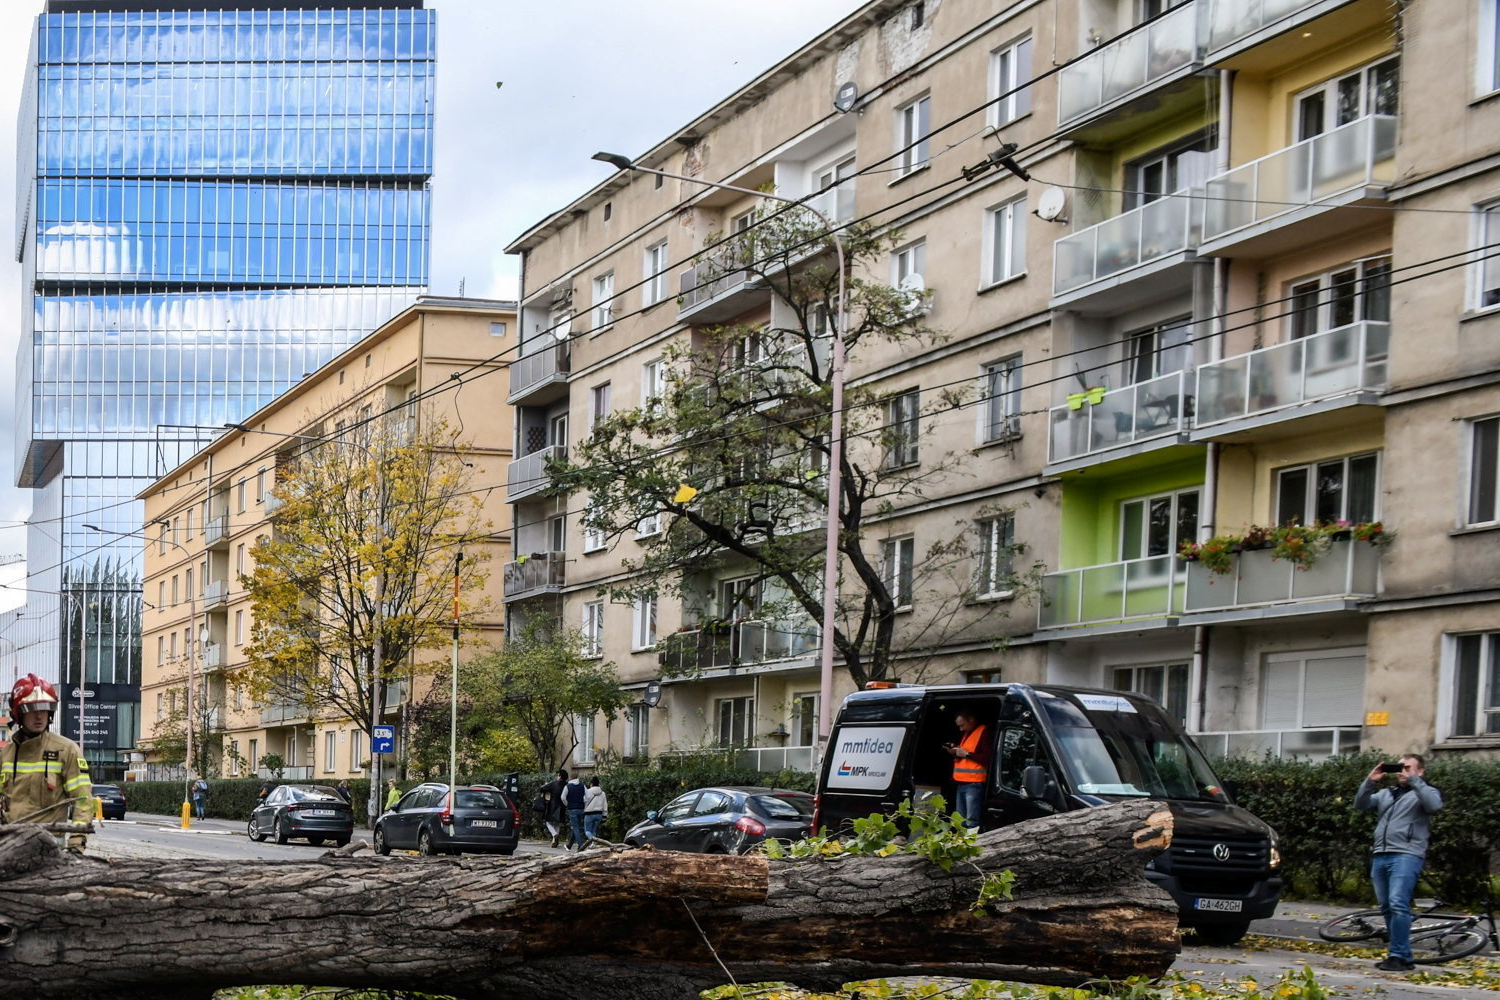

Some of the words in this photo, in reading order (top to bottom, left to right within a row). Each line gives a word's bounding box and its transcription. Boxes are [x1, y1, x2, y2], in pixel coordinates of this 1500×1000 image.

[850, 766, 869, 776] MPK
[1200, 899, 1211, 909] GA
[1214, 900, 1240, 911] 462GH
